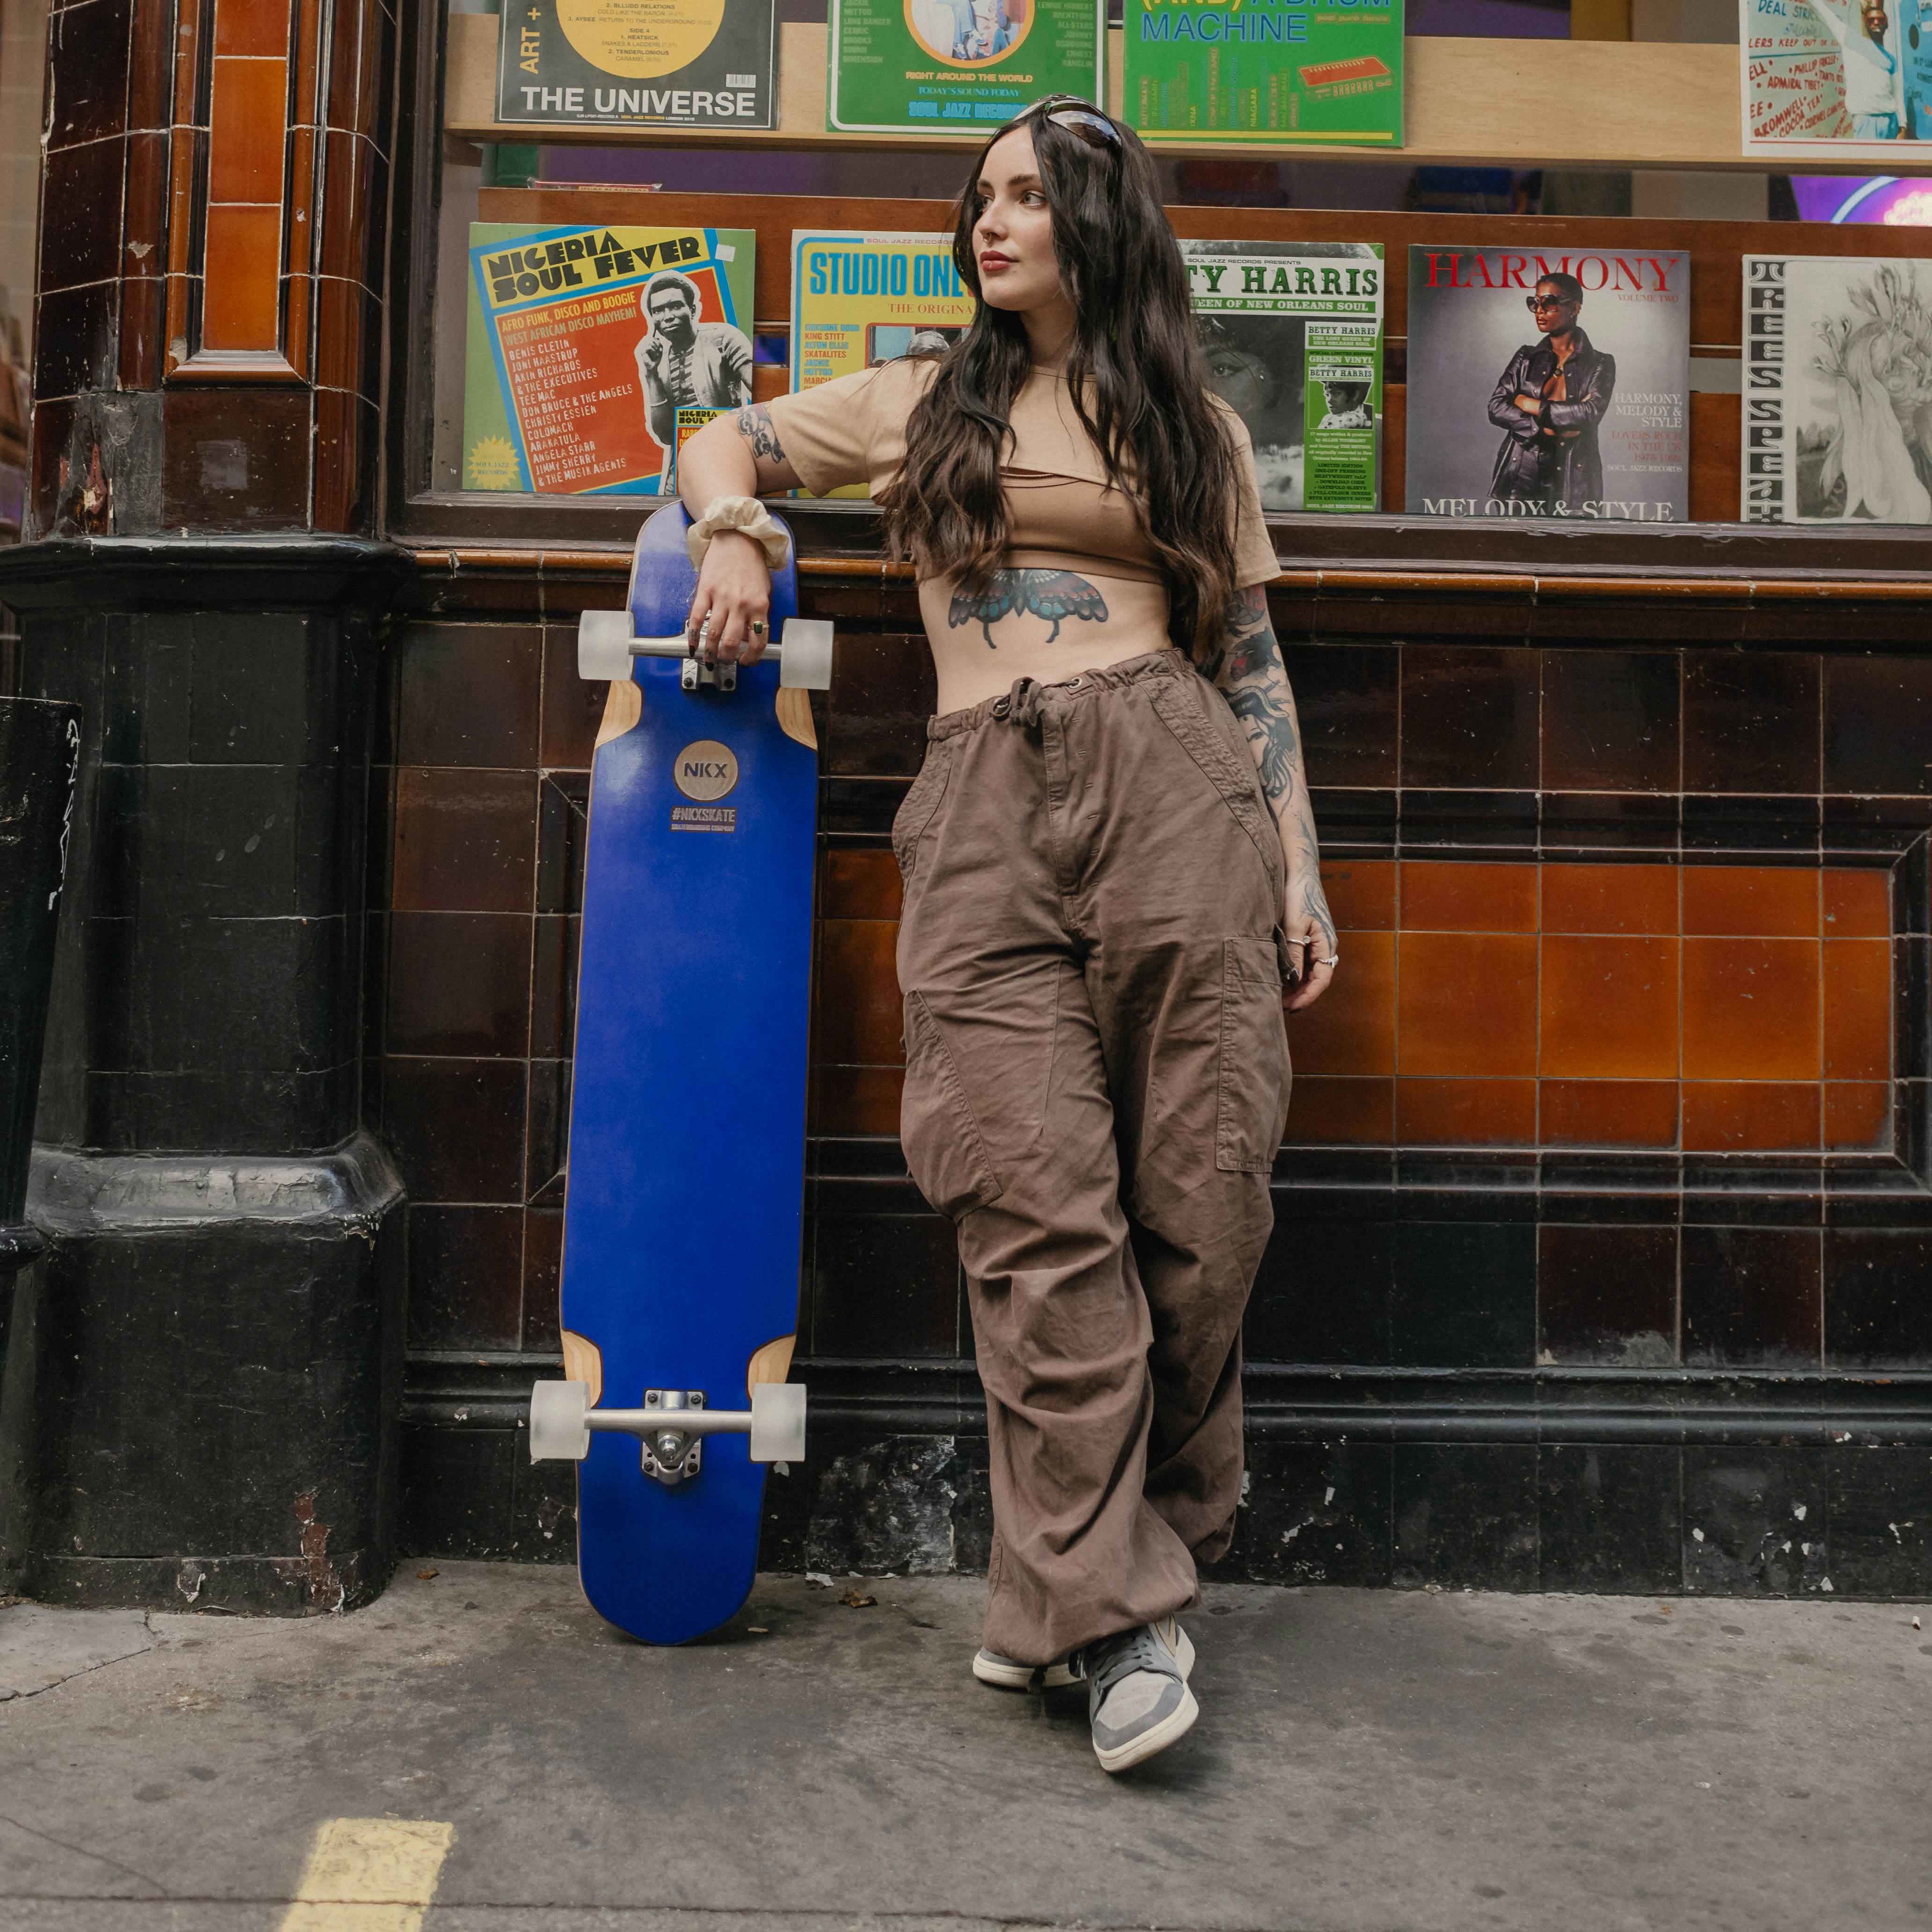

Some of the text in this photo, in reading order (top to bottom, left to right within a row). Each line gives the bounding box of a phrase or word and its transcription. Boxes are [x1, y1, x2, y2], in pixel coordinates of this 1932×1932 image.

[1758, 0, 1787, 16] DEAL
[1141, 13, 1308, 43] MACHINE
[520, 27, 540, 74] ART
[906, 71, 1033, 83] RIGHT AROUND THE WORLD
[1767, 76, 1820, 90] ADMIRAL TIBET
[521, 86, 756, 116] THE UNIVERSE
[991, 89, 1020, 97] TODAY
[942, 101, 972, 118] JAZZ
[973, 102, 1027, 120] RECORD
[1779, 109, 1805, 138] COCOA
[1807, 95, 1820, 112] TEA
[487, 230, 625, 279] NIGERIA
[493, 236, 701, 303] SOUL FEVER
[810, 252, 908, 297] STUDIO
[1241, 266, 1378, 296] HARRIS
[1423, 252, 1681, 293] HARMONY
[888, 303, 973, 314] THE ORIGINA
[1226, 299, 1243, 308] OF
[1247, 300, 1274, 309] NEW
[1277, 300, 1334, 311] ORLEANS
[1336, 301, 1368, 311] SOUL
[1659, 295, 1678, 303] TWO
[502, 291, 637, 333] AFRO FUNK, DISCO AND BOOGIE
[504, 307, 637, 345] WEST AFRICAN DISCO MAYHEM!
[509, 339, 569, 361] BENIS CLETIN
[512, 348, 578, 372] JONI HAASTRUP
[514, 359, 581, 384] AKIN RICHARDS
[517, 368, 598, 395] & THE EXECUTIVES
[519, 389, 556, 406] TEE MAC
[522, 384, 634, 418] DON BRUCE & THE ANGELS
[1614, 393, 1682, 405] HARMONY,
[525, 405, 597, 429] CHRISTY ESSIEN
[1615, 405, 1682, 417] MELODY &
[1642, 417, 1682, 428] STYLE
[527, 421, 574, 440] COLOMACH
[531, 432, 581, 453] ARAKATULA
[533, 440, 596, 464] ANGELA STARR
[1628, 441, 1640, 450] IN
[1643, 441, 1663, 450] THE
[536, 453, 596, 476] JIMMY SHERRY
[538, 457, 626, 486] & THE MUSIK AGENTS
[1422, 498, 1675, 522] MELODY & STYLE
[683, 762, 728, 779] NKX
[672, 807, 736, 823] #NKXSKATE
